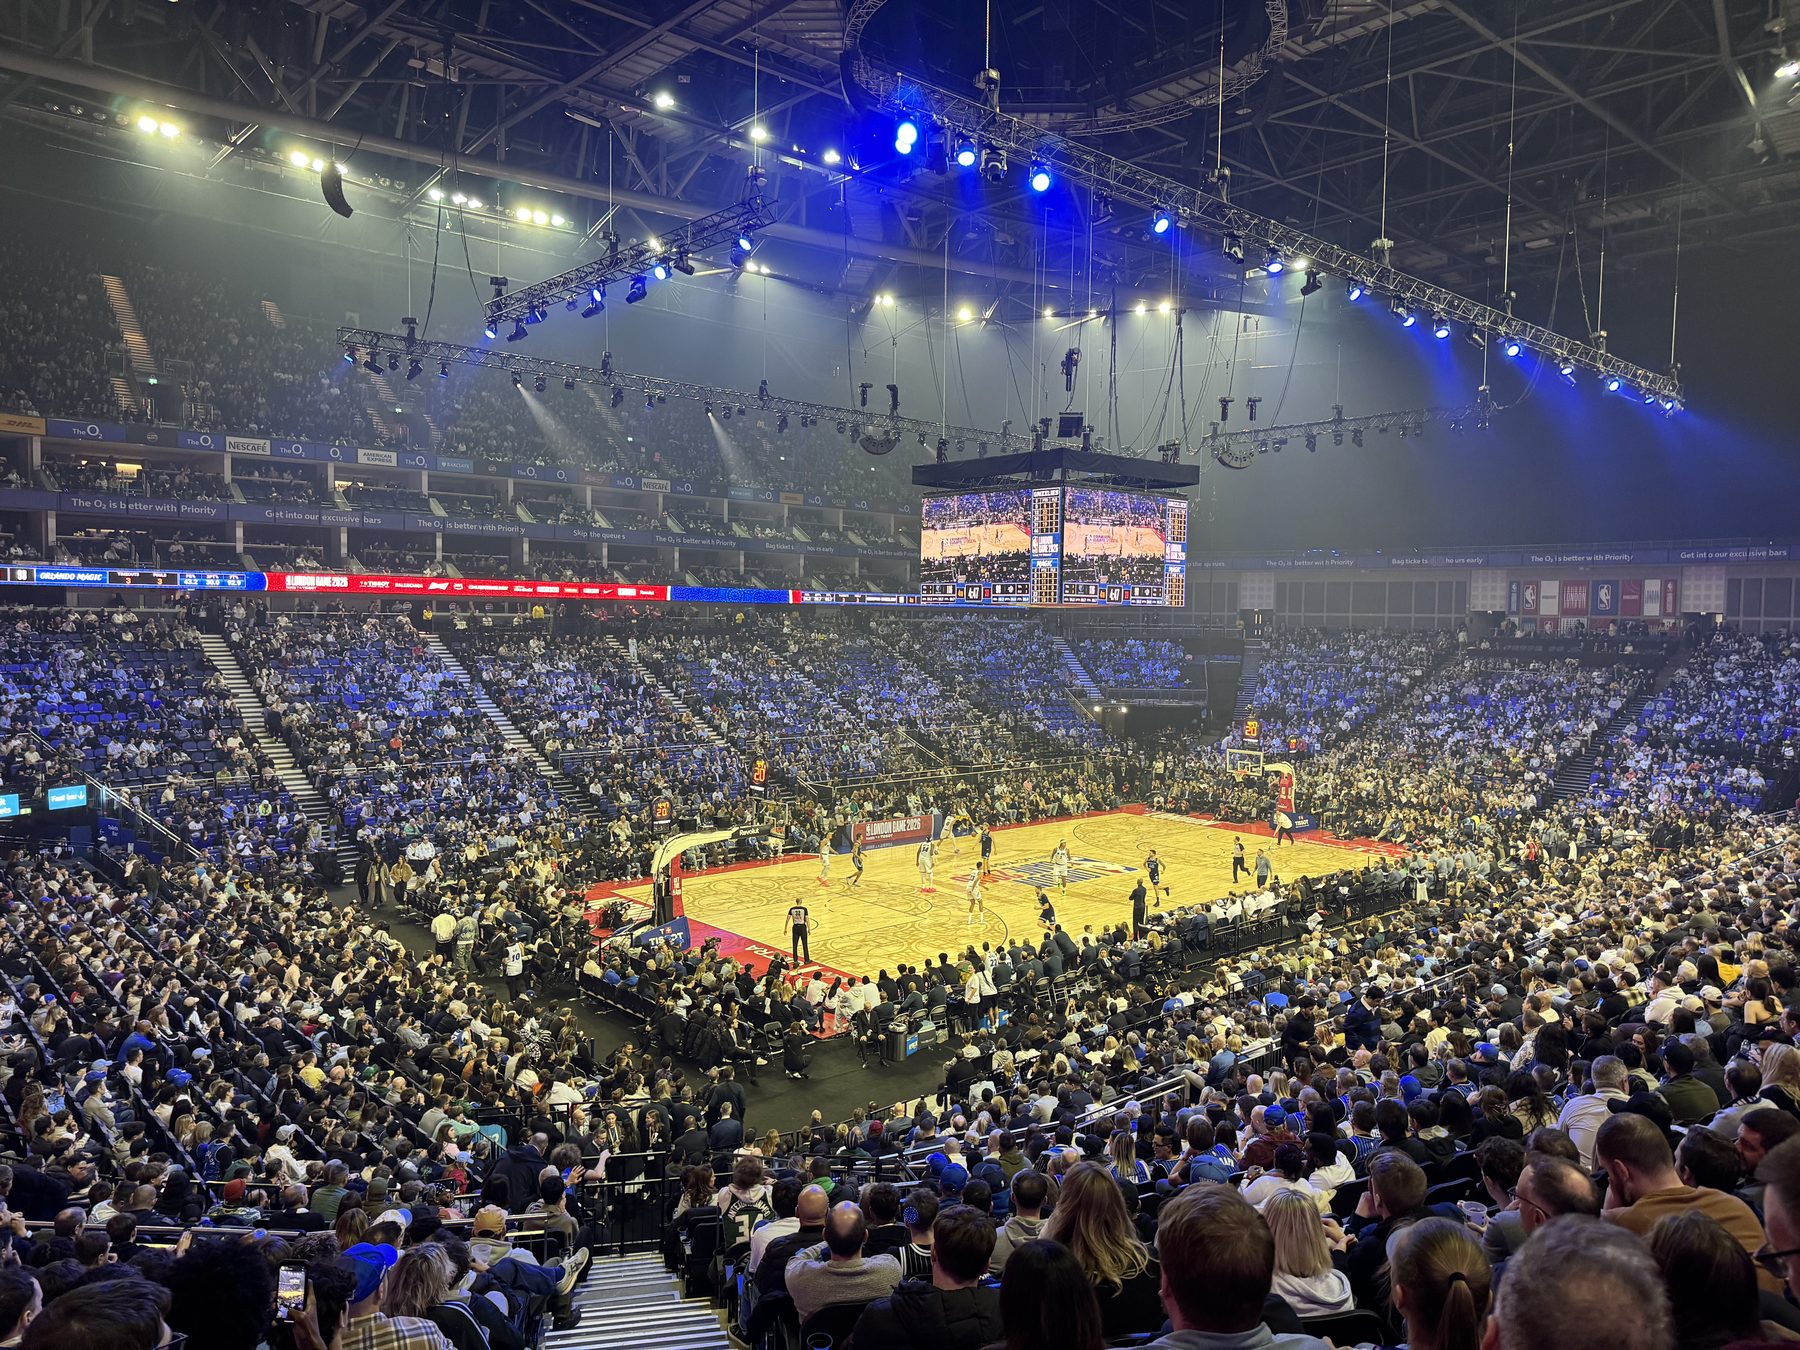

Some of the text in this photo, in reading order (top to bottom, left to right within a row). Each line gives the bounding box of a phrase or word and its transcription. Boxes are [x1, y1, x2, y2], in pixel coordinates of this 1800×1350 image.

[72, 428, 86, 436] The
[187, 438, 199, 446] The
[228, 440, 267, 453] NESCAFÉ
[72, 498, 91, 507] The
[109, 501, 117, 509] is
[120, 501, 153, 511] better
[155, 505, 176, 513] with
[181, 505, 217, 516] Priority
[265, 510, 283, 518] Get
[285, 511, 303, 519] into
[363, 516, 381, 524] bars
[454, 522, 477, 530] better
[498, 525, 525, 534] Priority
[573, 529, 588, 539] Skip
[1605, 554, 1633, 562] Priority
[1681, 551, 1694, 559] Get
[1466, 557, 1483, 565] early
[40, 572, 102, 581] ORLANDO MAGIC
[1245, 727, 1257, 737] 20
[753, 767, 766, 782] 20
[656, 808, 668, 817] 20
[870, 817, 921, 836] LONDON GAME 2026
[740, 828, 760, 837] Revolut
[649, 932, 684, 946] TISOT
[512, 953, 520, 962] 10
